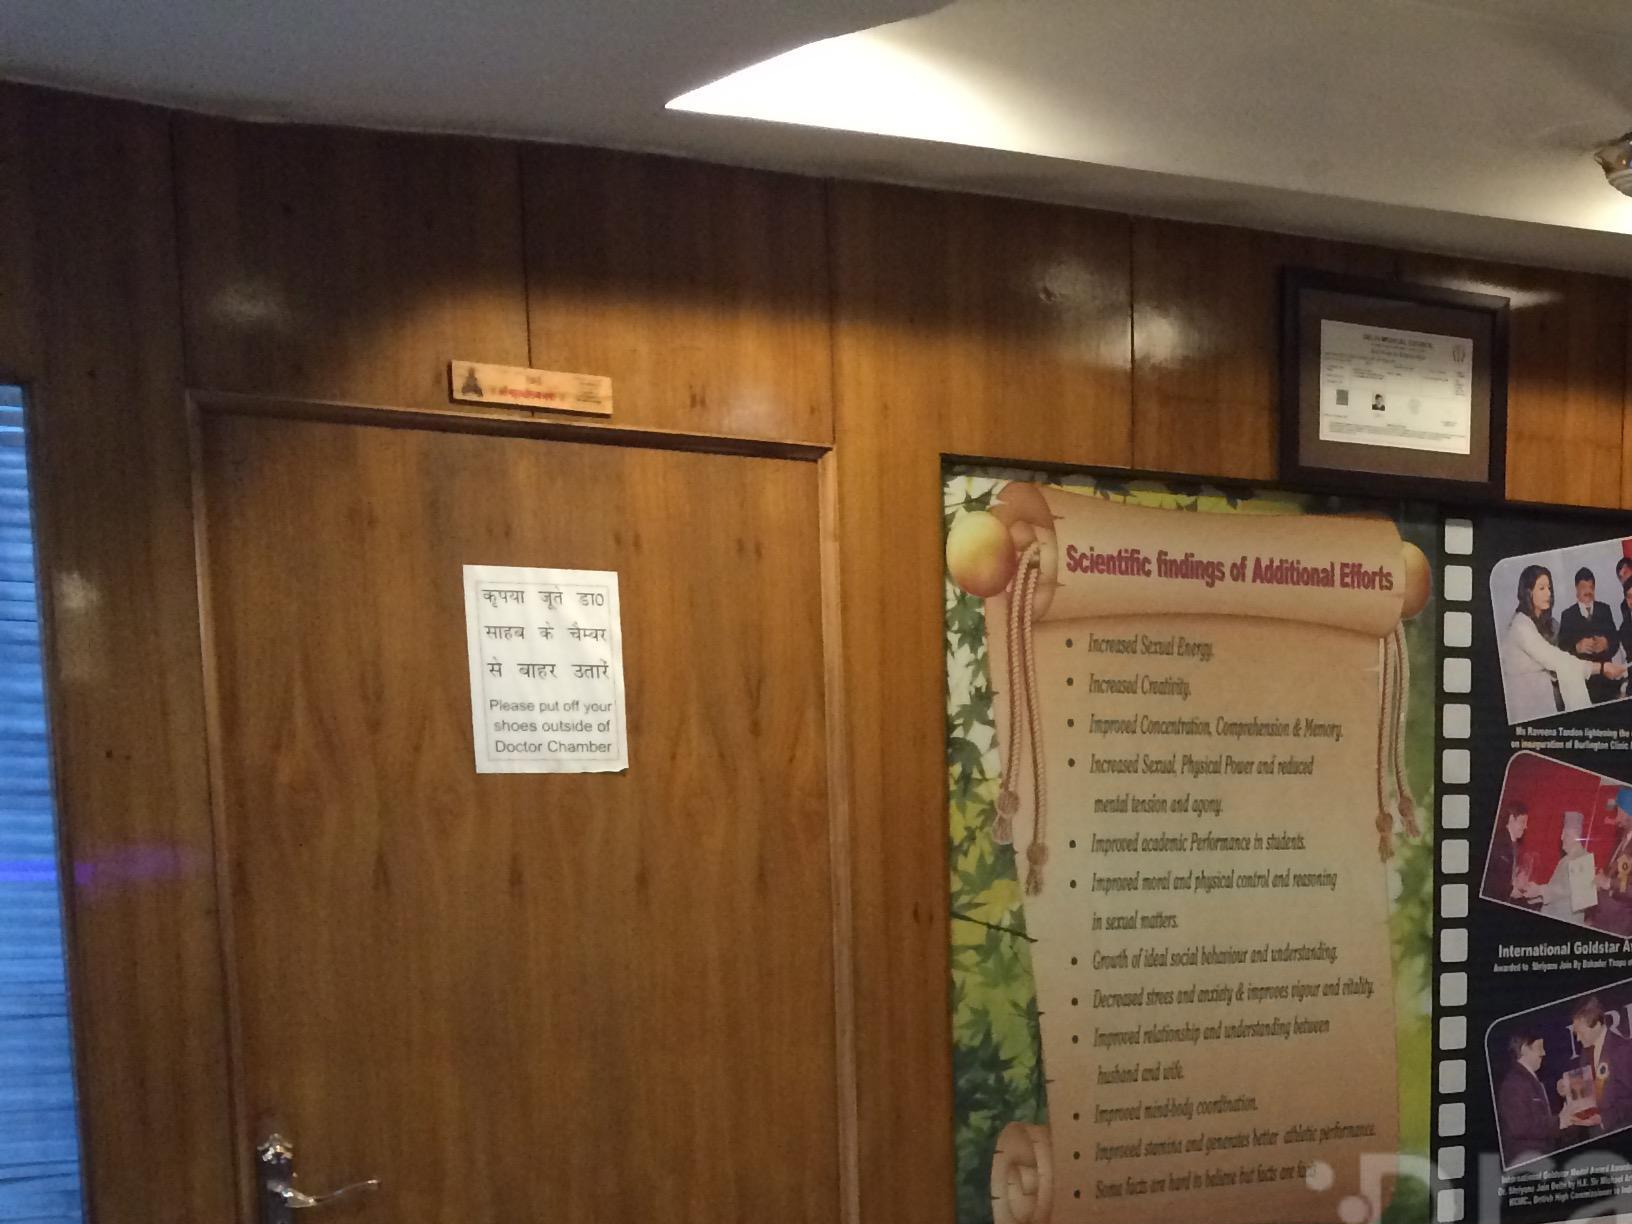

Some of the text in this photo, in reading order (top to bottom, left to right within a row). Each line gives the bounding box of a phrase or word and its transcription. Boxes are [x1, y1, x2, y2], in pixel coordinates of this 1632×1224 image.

[1066, 544, 1393, 591] Scientific findings of Additional Efforts
[482, 589, 524, 608] कृपया
[538, 585, 563, 610] जूते
[484, 625, 525, 640] साहब
[537, 621, 554, 640] के
[1088, 633, 1138, 654] Increased
[1141, 634, 1175, 656] Sexual
[487, 656, 502, 677] से
[517, 663, 557, 678] बाहर
[1089, 673, 1139, 695] Increased
[489, 699, 612, 714] Please put off your
[494, 720, 610, 732] shoes outside of
[1089, 713, 1138, 738] Improved
[1216, 715, 1290, 740] Comprehension
[1293, 717, 1302, 737] &
[1618, 728, 1630, 738] the
[495, 740, 612, 753] Doctor Chamber
[1610, 741, 1629, 750] Clinic
[1090, 753, 1140, 774] Increased
[1181, 753, 1223, 778] Physical
[1225, 754, 1255, 775] Power
[1257, 754, 1276, 775] and
[1278, 754, 1314, 775] reduced
[1094, 793, 1129, 813] mental
[1132, 793, 1168, 813] tension
[1171, 792, 1190, 813] and
[1091, 832, 1140, 856] Improved
[1142, 831, 1188, 852] academic
[1190, 831, 1250, 852] Performance
[1254, 832, 1264, 850] in
[1092, 872, 1140, 895] Improved
[1142, 870, 1171, 890] moral
[1173, 869, 1193, 890] and
[1195, 869, 1234, 893] physical
[1236, 869, 1270, 888] control
[1272, 868, 1290, 888] and
[1092, 911, 1103, 930] in
[1105, 909, 1138, 930] sexual
[1093, 948, 1129, 970] Growth
[1131, 947, 1144, 969] of
[1170, 945, 1199, 966] social
[1250, 943, 1269, 963] and
[1498, 941, 1571, 958] International
[1574, 940, 1620, 955] Goldstar
[1093, 987, 1144, 1008] Decreased
[1177, 984, 1196, 1004] and
[1197, 983, 1233, 1006] anxiety
[1235, 982, 1244, 1001] &
[1322, 976, 1341, 997] and
[1094, 1015, 1330, 1050] Improved relationship and understanding between
[1094, 1100, 1142, 1125] Improved
[1095, 1138, 1142, 1163] Improved
